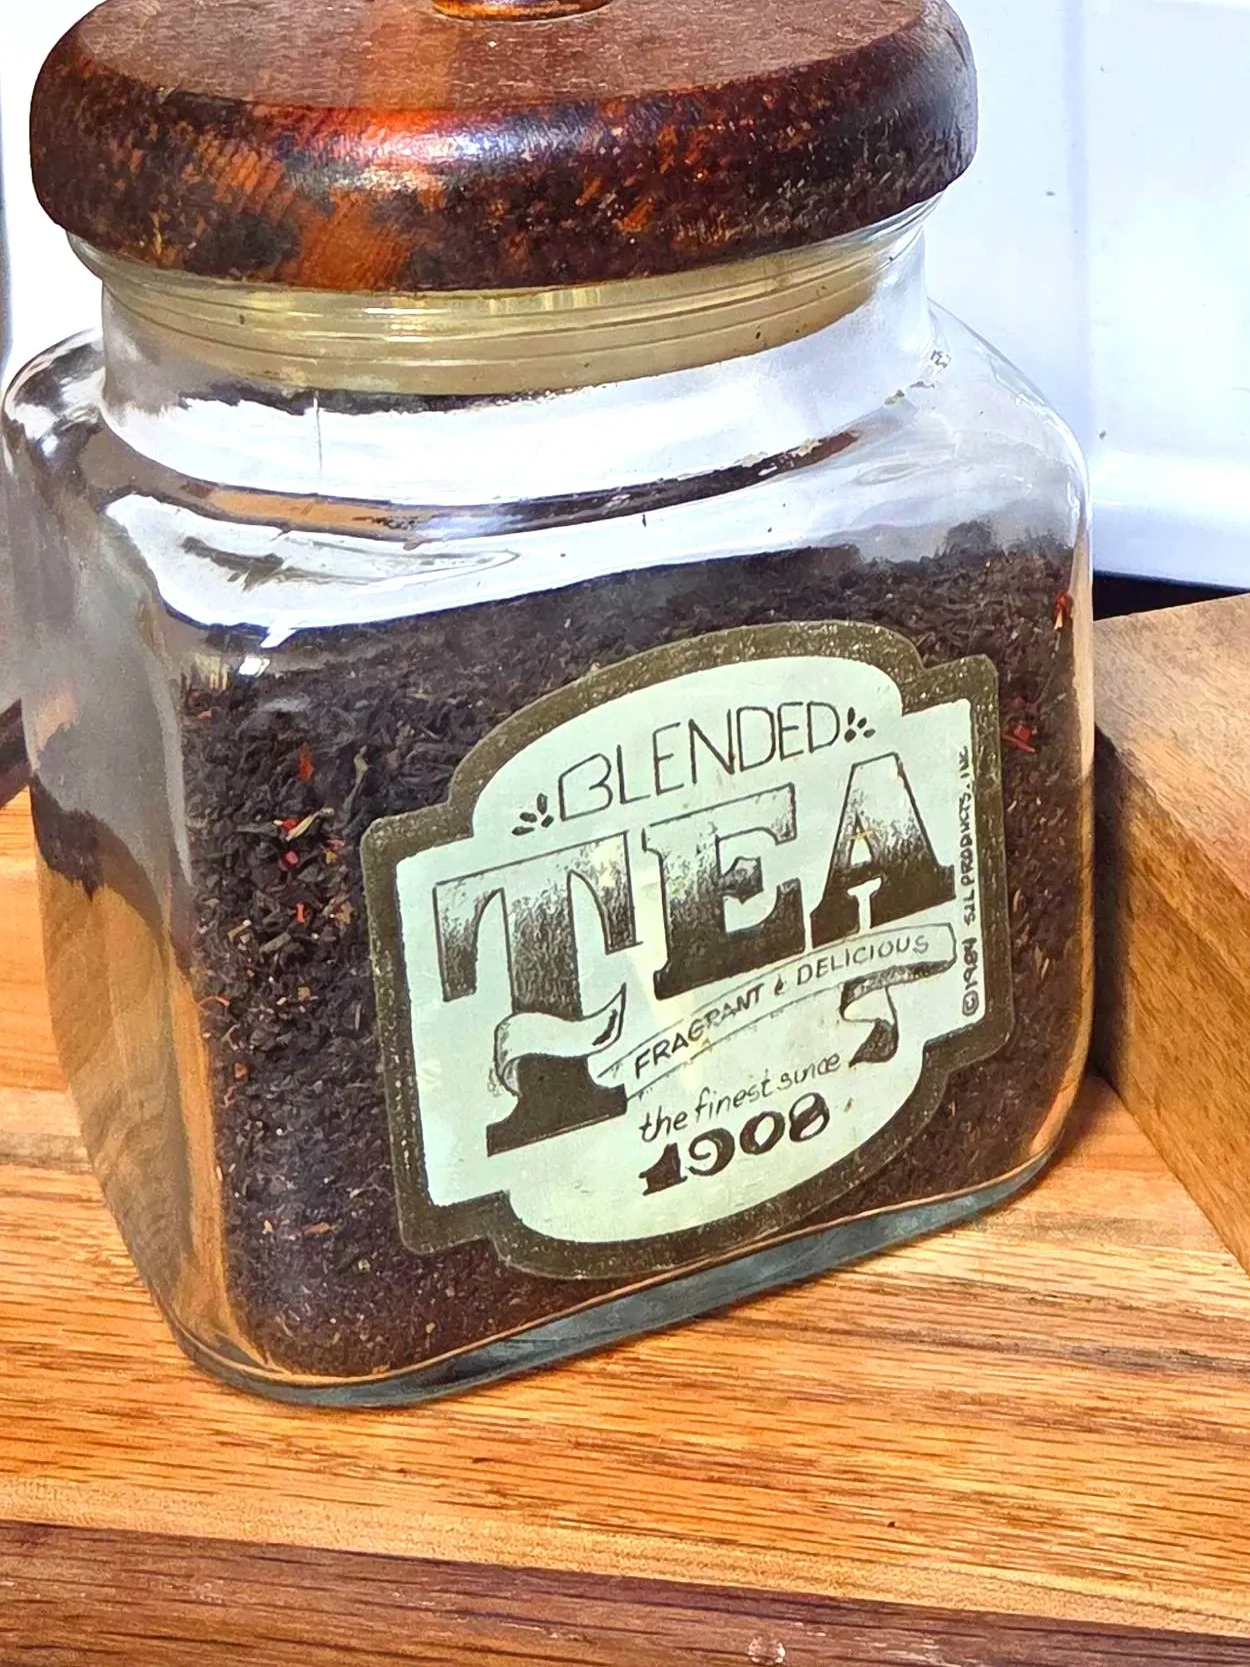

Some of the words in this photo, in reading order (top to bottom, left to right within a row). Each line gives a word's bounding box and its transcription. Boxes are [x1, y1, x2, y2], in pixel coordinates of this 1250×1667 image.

[558, 701, 841, 821] BLENDED
[433, 752, 956, 1158] TEA
[633, 983, 764, 1079] FRAGRANT
[796, 934, 930, 986] DELICIOUS
[638, 1091, 830, 1196] 1908
[639, 1104, 689, 1143] the
[693, 1069, 773, 1123] finest
[779, 1053, 842, 1090] since
